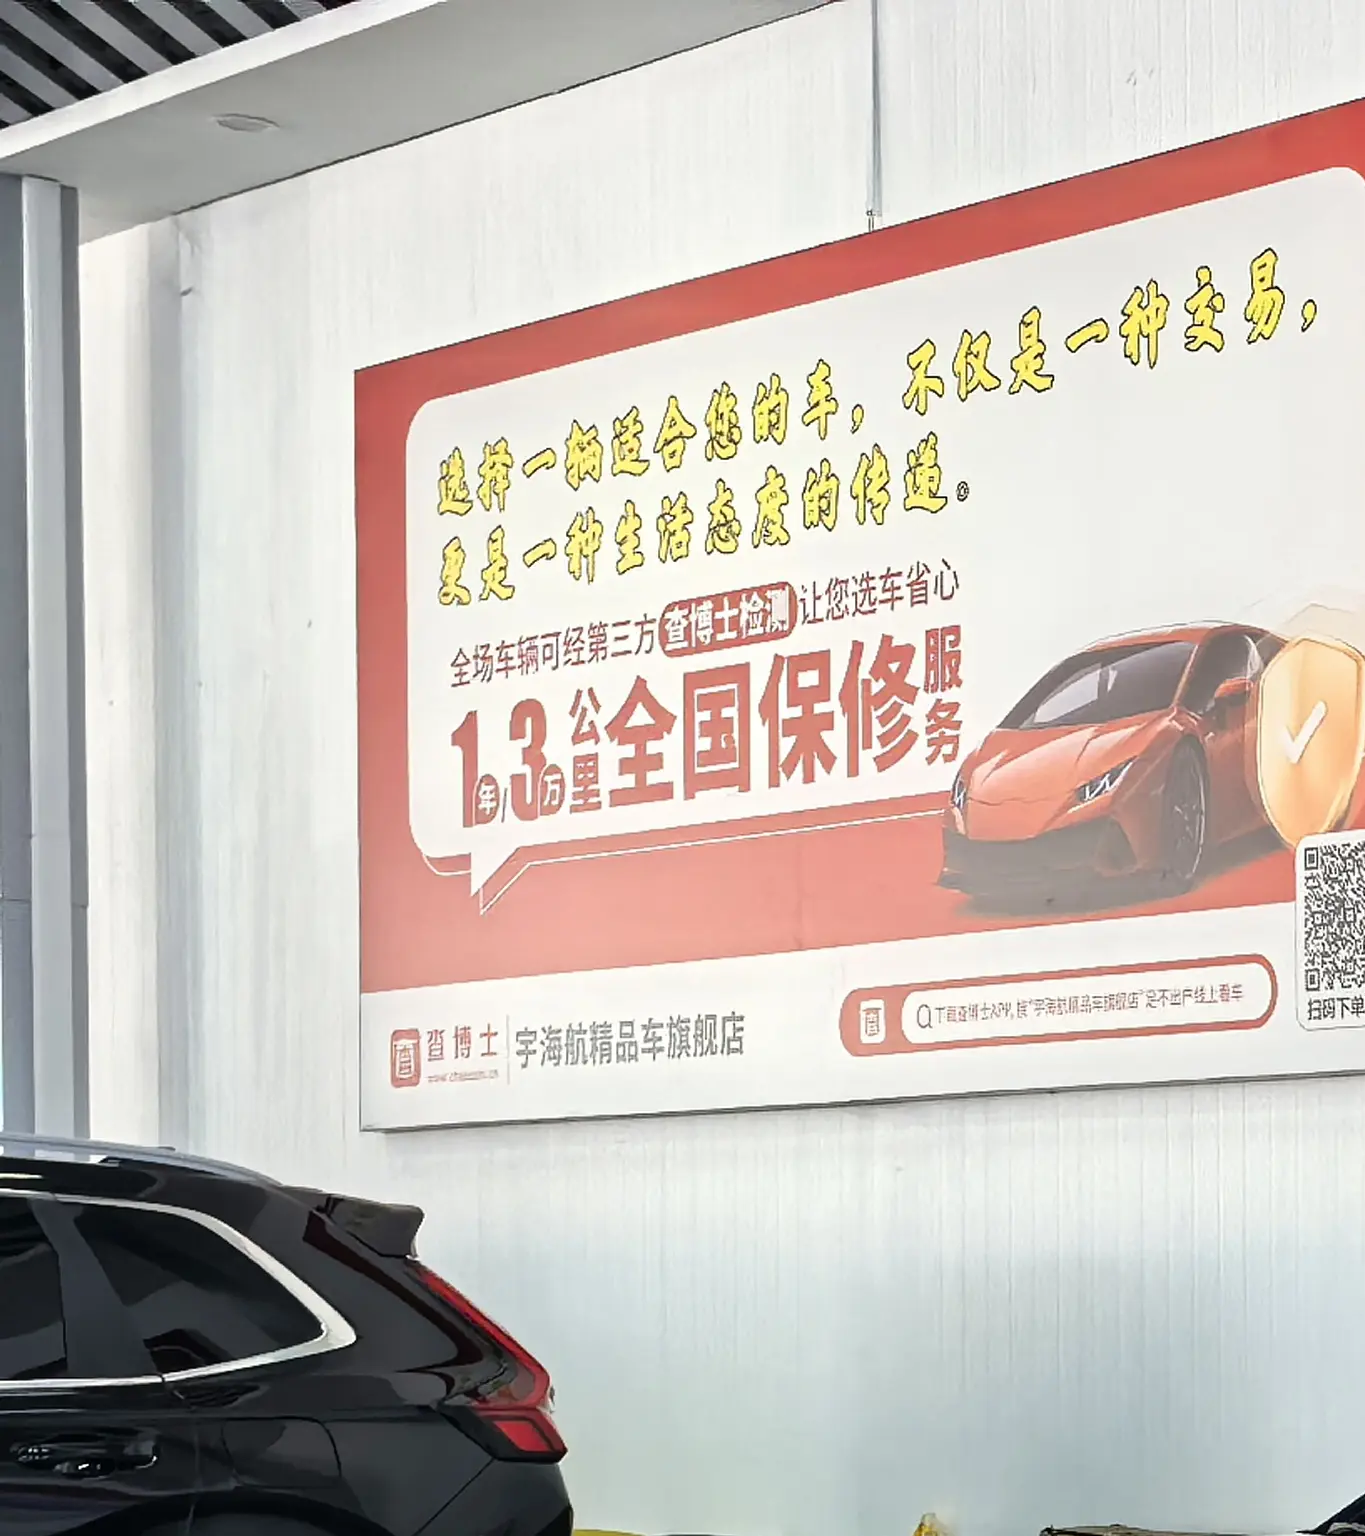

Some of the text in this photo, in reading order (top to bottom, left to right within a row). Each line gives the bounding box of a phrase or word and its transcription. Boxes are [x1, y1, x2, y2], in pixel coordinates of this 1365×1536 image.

[515, 1011, 746, 1069] 宇海航精品车旗舰店
